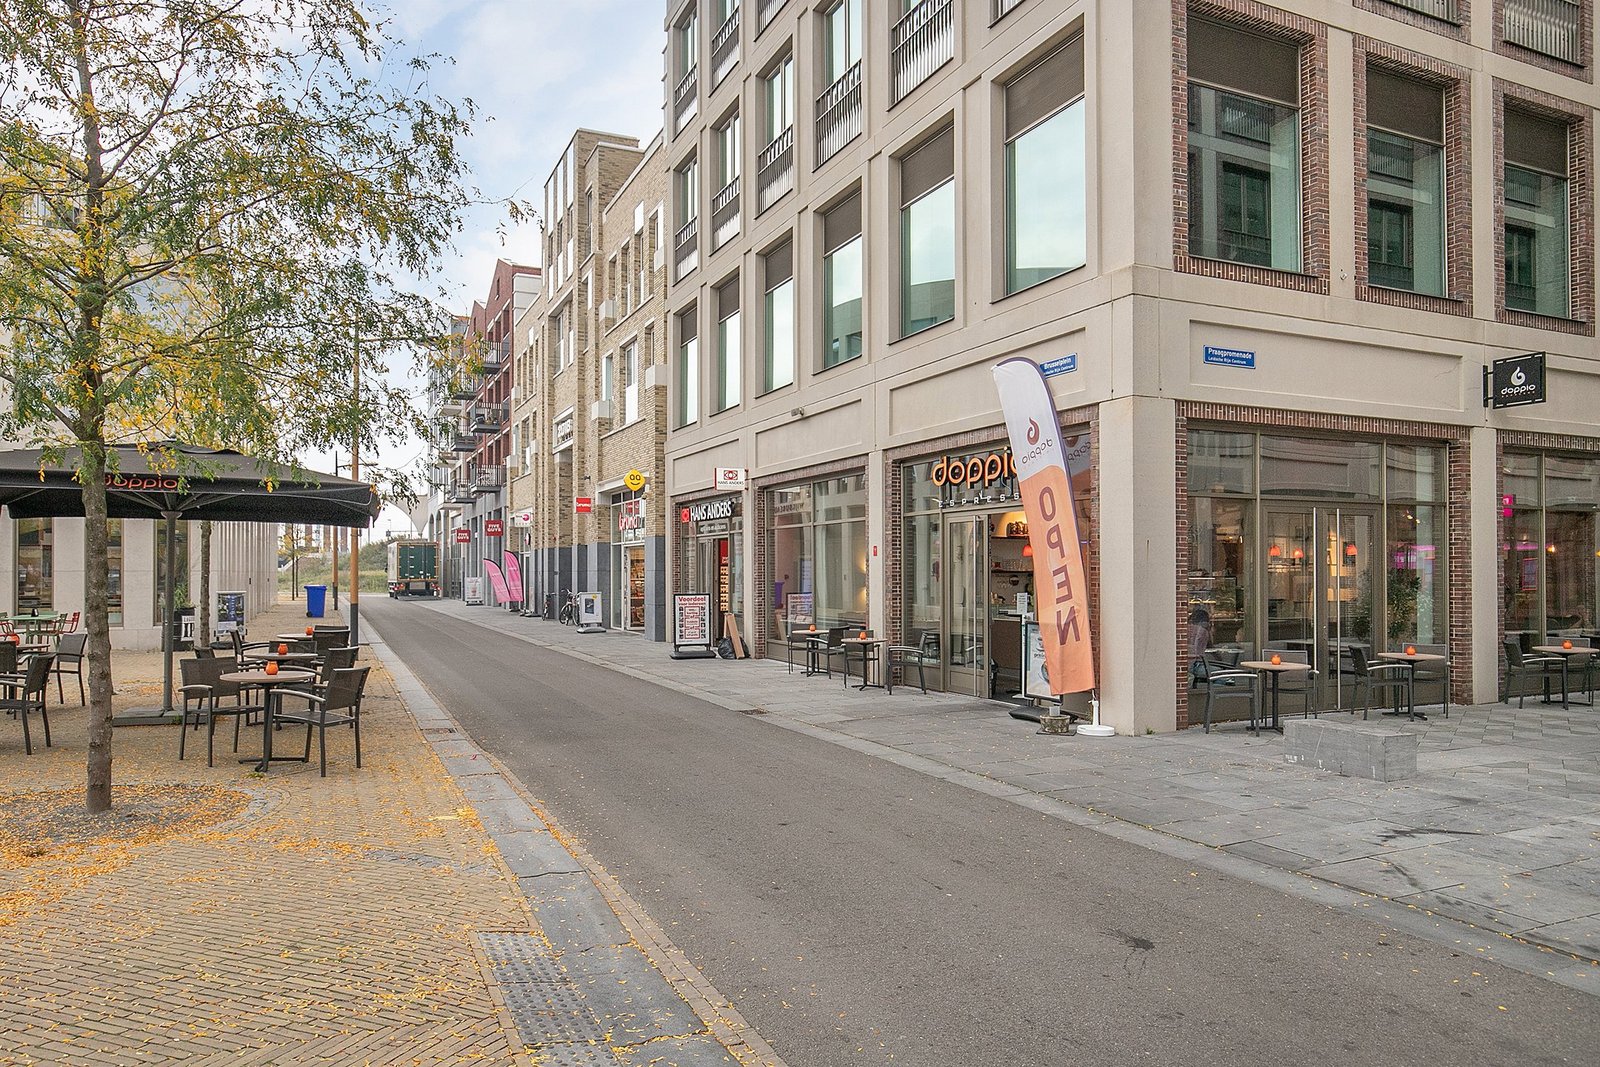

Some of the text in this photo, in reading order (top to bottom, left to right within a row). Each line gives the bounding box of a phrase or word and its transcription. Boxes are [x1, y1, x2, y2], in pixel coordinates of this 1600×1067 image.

[1208, 347, 1252, 360] Praagpromenade
[1043, 357, 1072, 370] Brusselplein
[1501, 384, 1536, 395] doppio
[690, 501, 732, 521] HANS ANDERS
